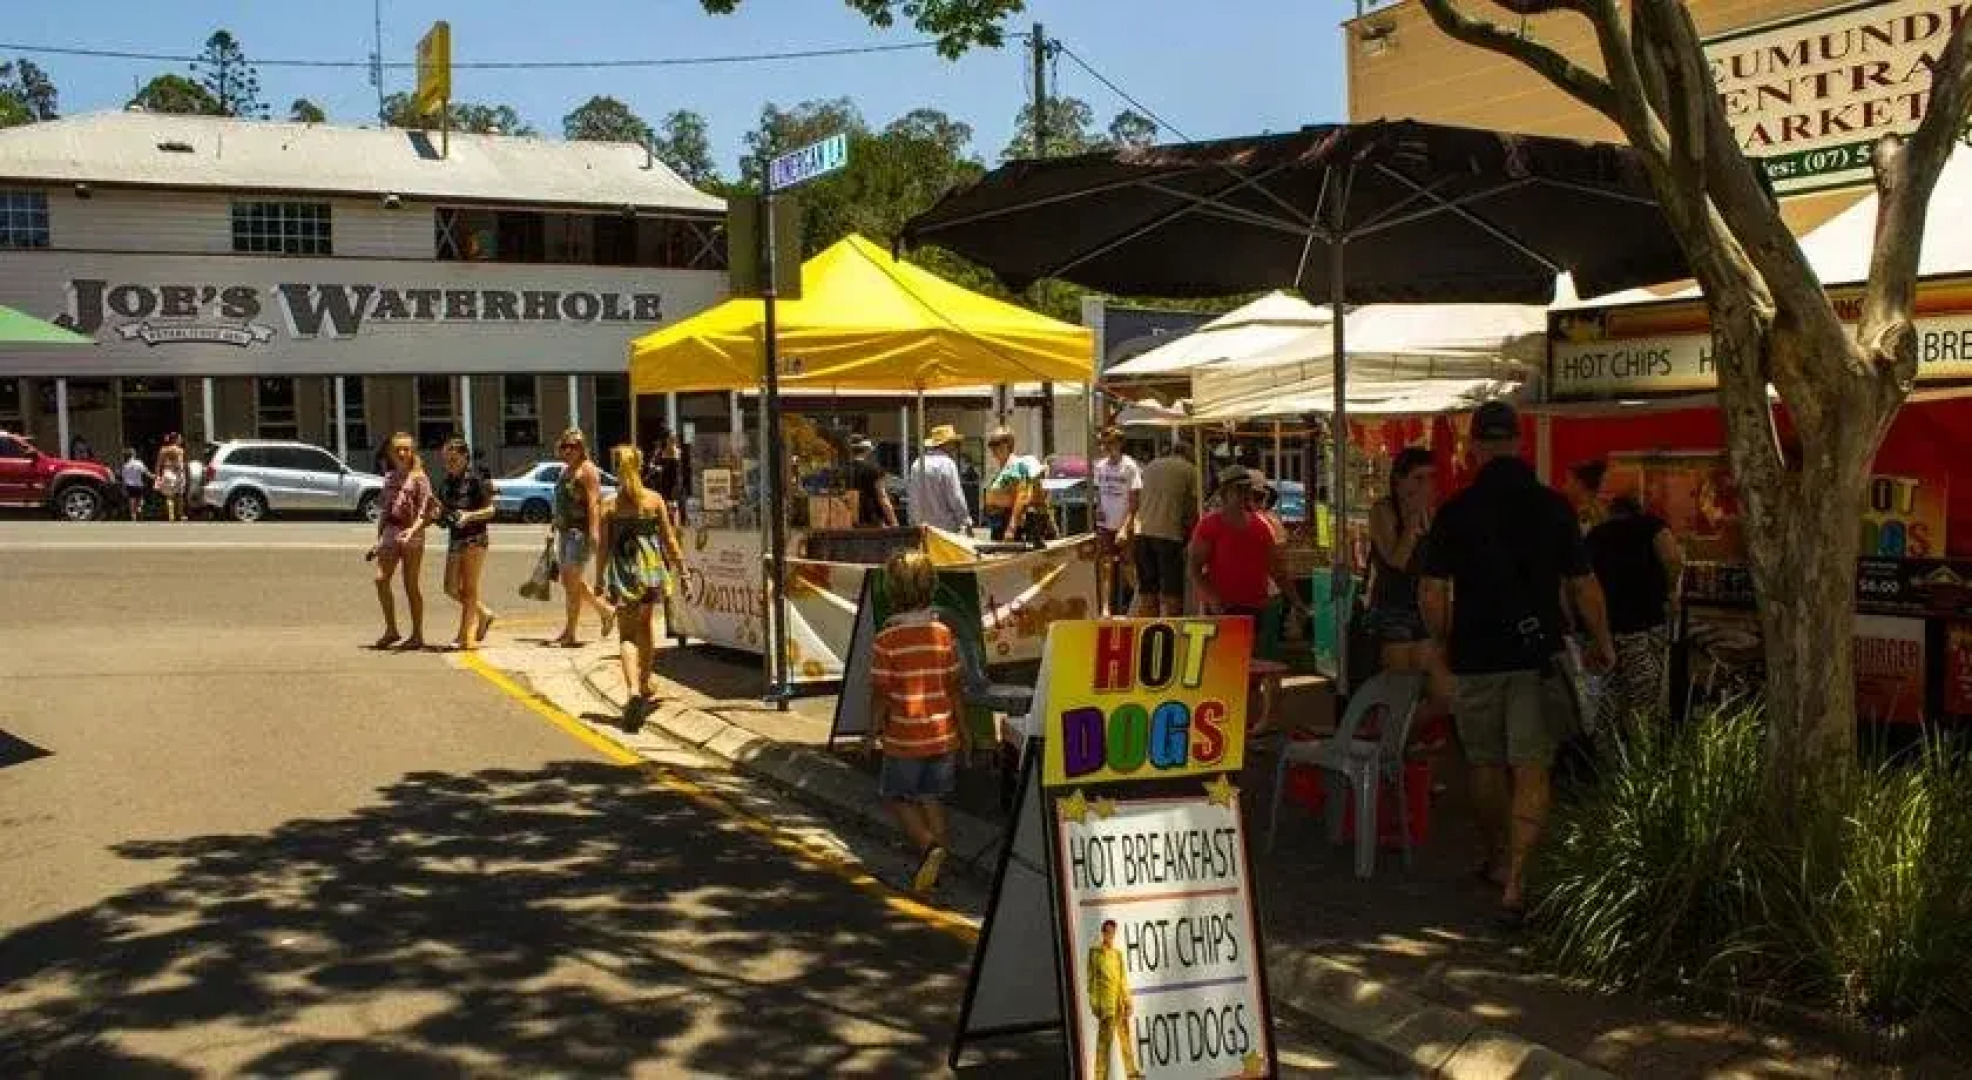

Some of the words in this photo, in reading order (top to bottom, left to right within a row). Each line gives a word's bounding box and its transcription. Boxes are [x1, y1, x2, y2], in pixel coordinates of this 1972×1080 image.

[1719, 52, 1934, 115] ENTRA
[1742, 89, 1931, 149] ARKET
[1804, 147, 1848, 172] (07)
[53, 279, 262, 336] JOE'S
[275, 284, 664, 339] WATERHOLE
[1563, 353, 1608, 379] HOT
[1610, 347, 1673, 378] CHIPS
[1868, 478, 1919, 514] OT
[1859, 519, 1931, 558] OGS
[1092, 622, 1217, 695] HOT
[1061, 700, 1229, 778] DOGS
[1070, 835, 1116, 890] HOT
[1121, 827, 1237, 886] BREAKFAST
[1124, 918, 1170, 973] HOT
[1175, 911, 1239, 967] CHIPS
[1135, 1011, 1182, 1070] HOT
[1186, 1002, 1251, 1061] DOGS
